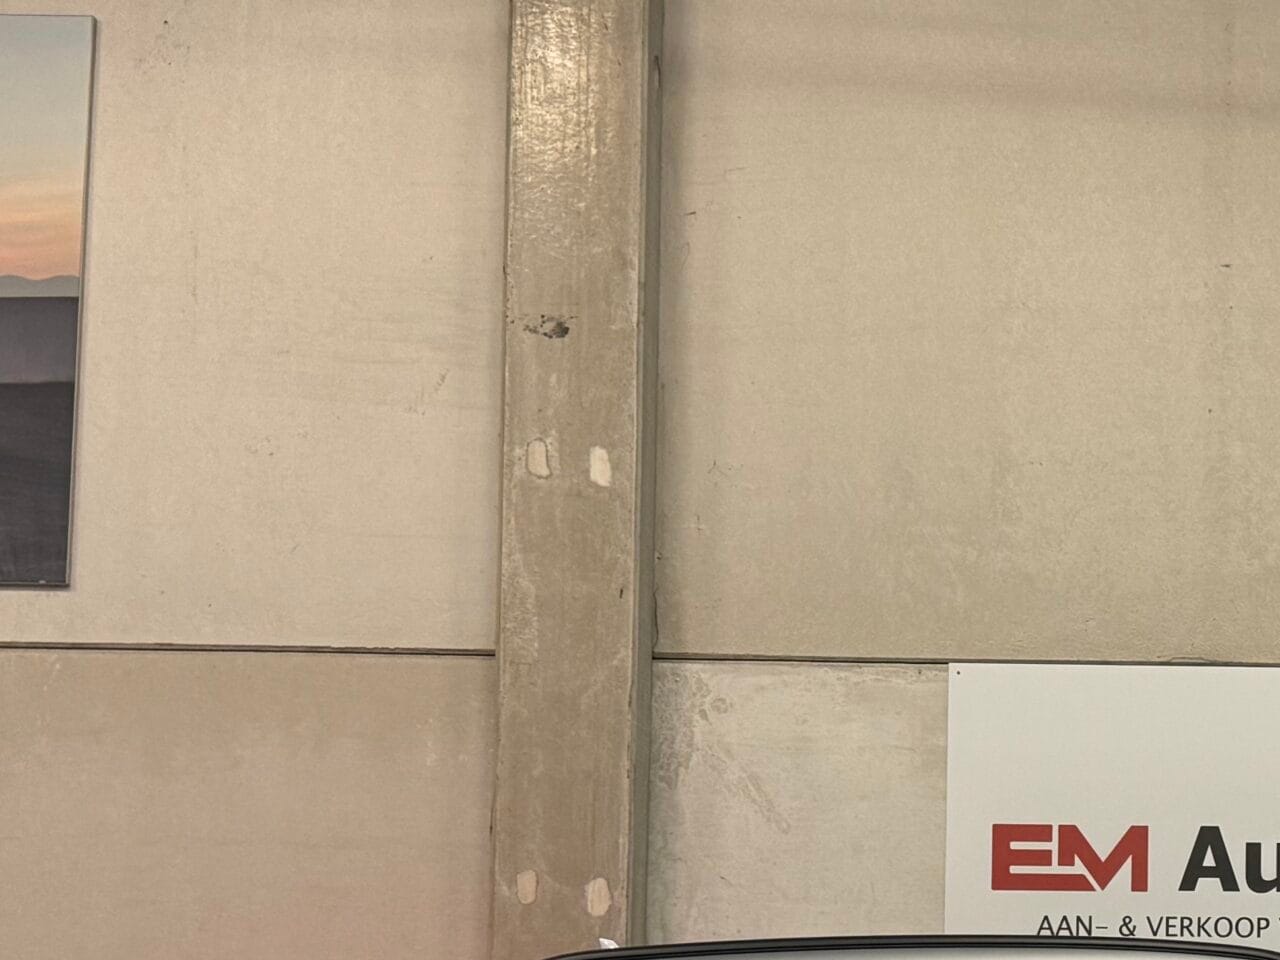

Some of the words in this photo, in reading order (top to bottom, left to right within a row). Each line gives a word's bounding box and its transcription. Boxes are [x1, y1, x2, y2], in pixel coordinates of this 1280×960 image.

[991, 823, 1149, 893] EM
[1036, 914, 1109, 937] AAN-
[1118, 915, 1137, 938] &
[1146, 915, 1271, 939] VERKOOP
